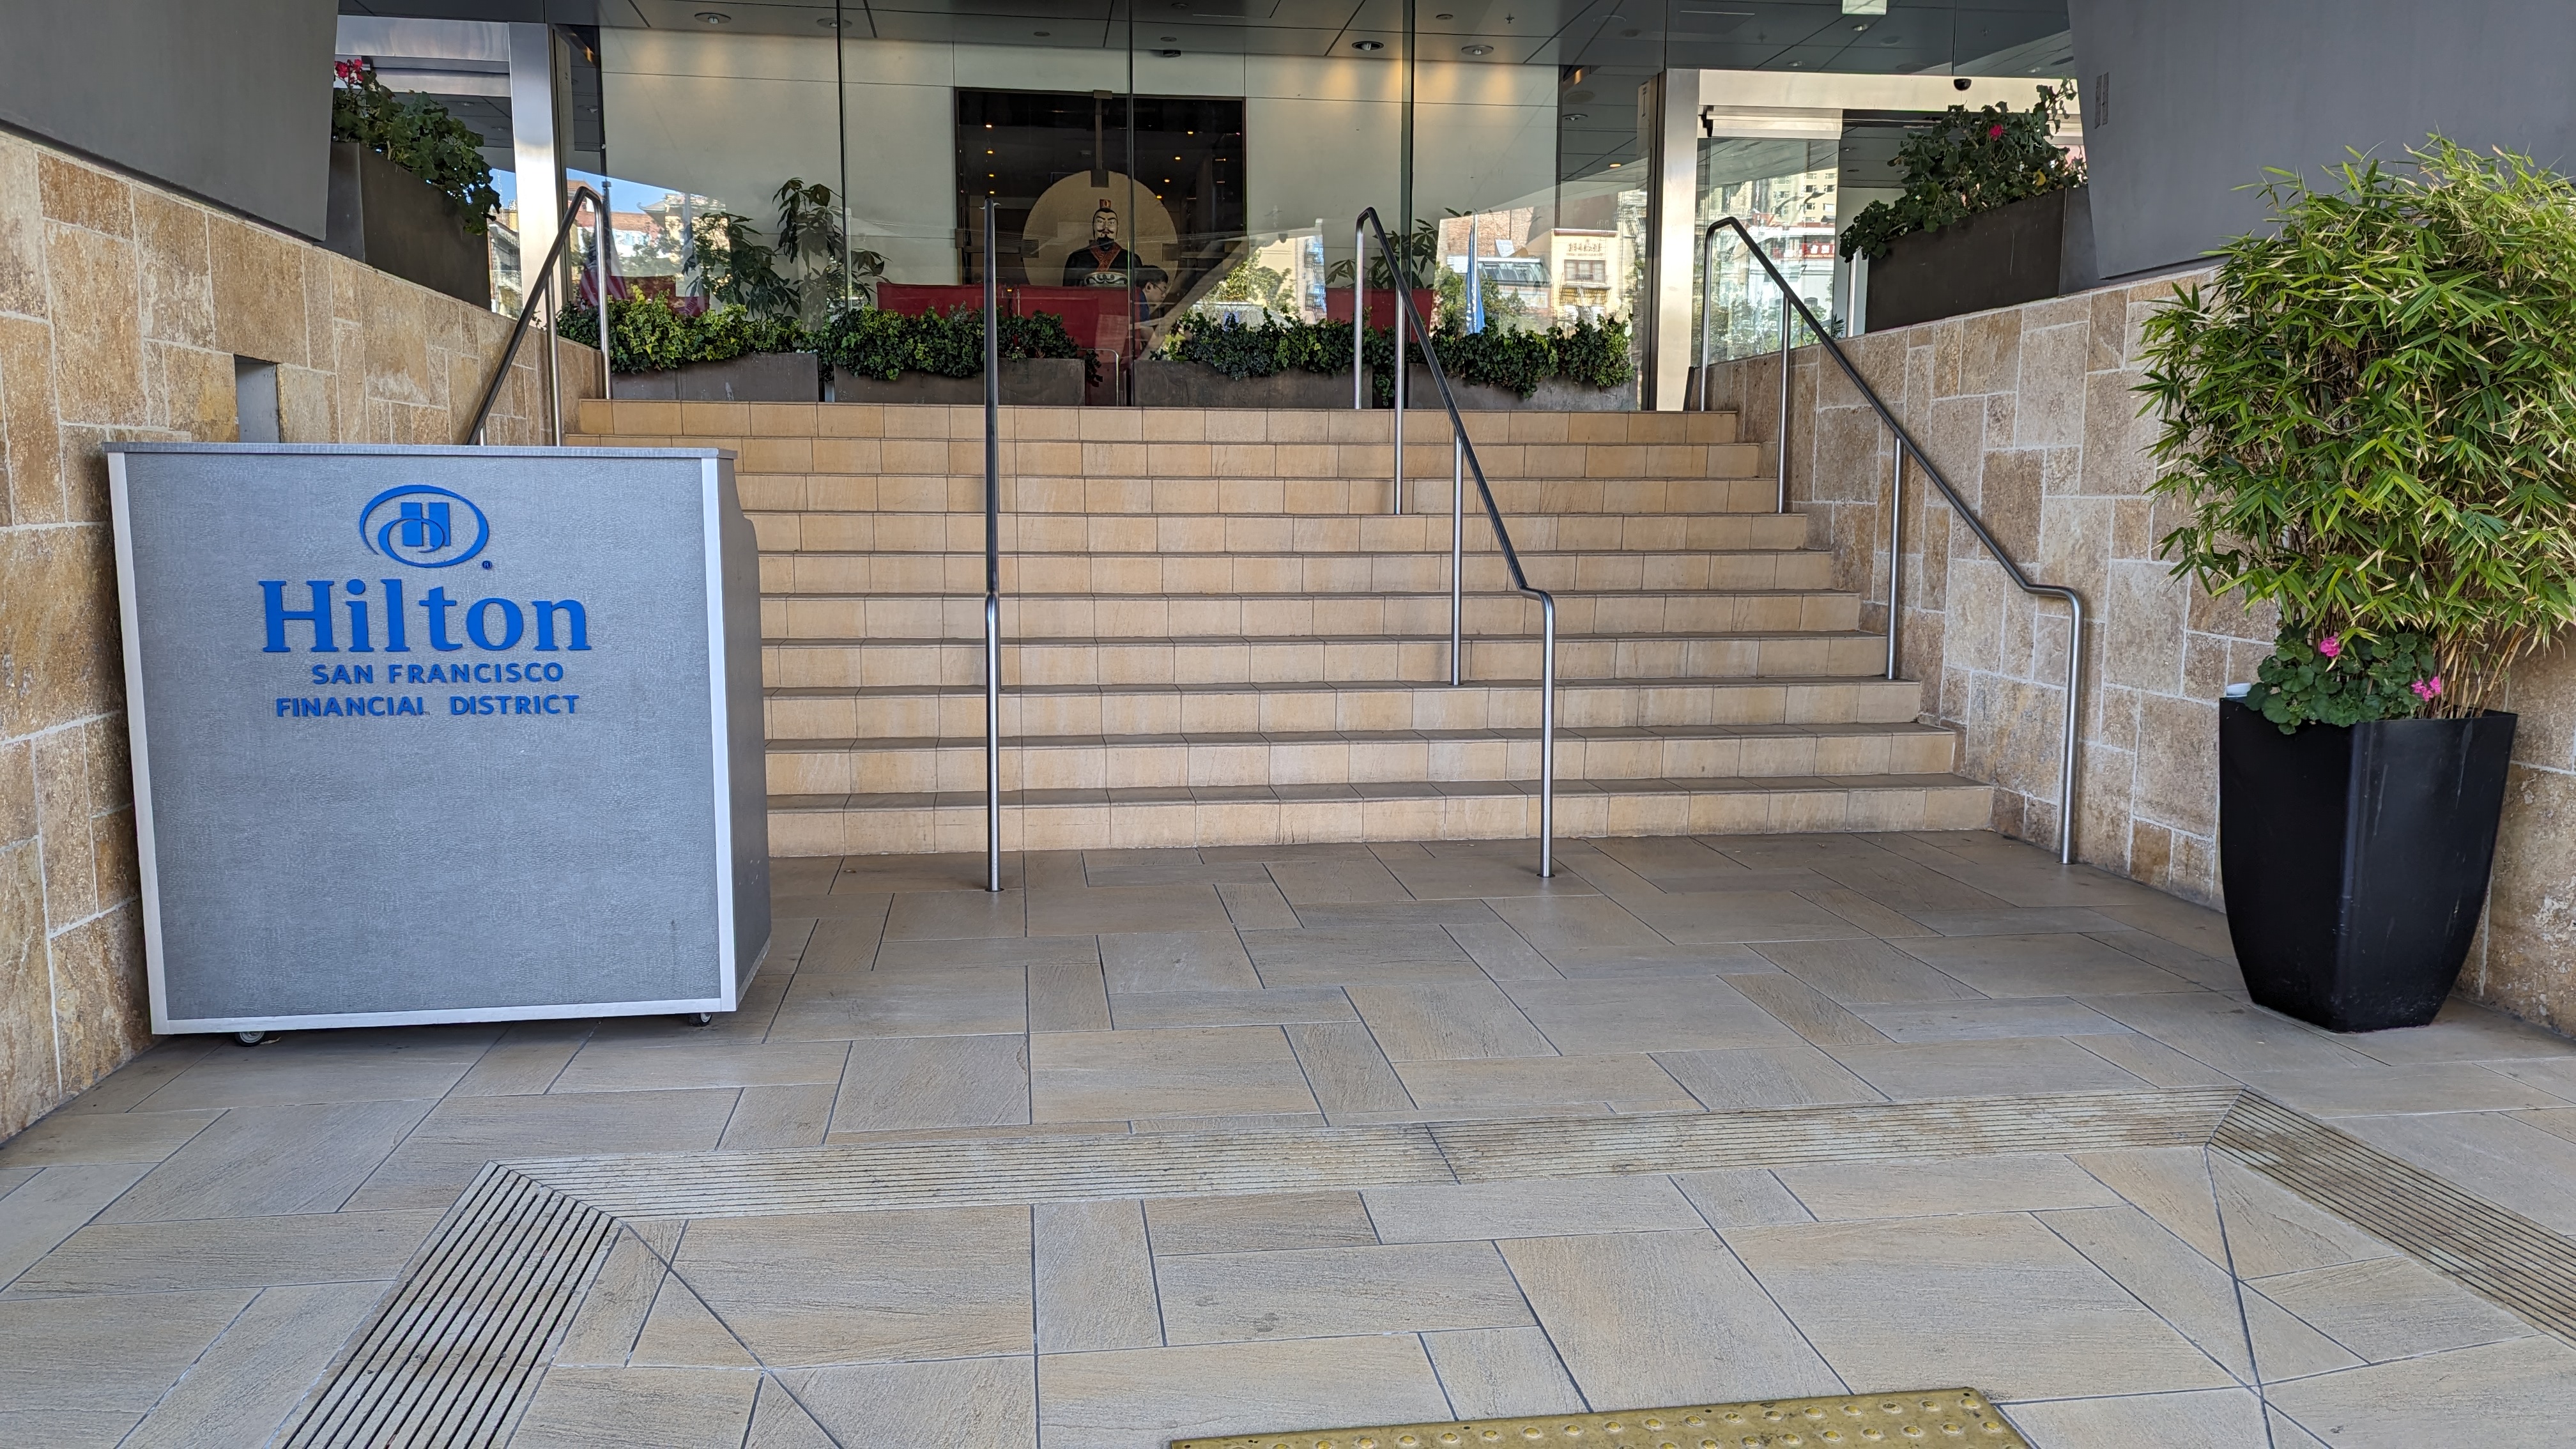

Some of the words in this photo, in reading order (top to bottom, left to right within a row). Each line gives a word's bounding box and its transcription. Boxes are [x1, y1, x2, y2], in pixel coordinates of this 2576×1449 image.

[259, 579, 592, 653] Hilton
[312, 664, 374, 684] SAN
[388, 662, 564, 684] FRANCISCO
[276, 696, 424, 717] FINANCIAL
[450, 694, 579, 716] DISTRICT
